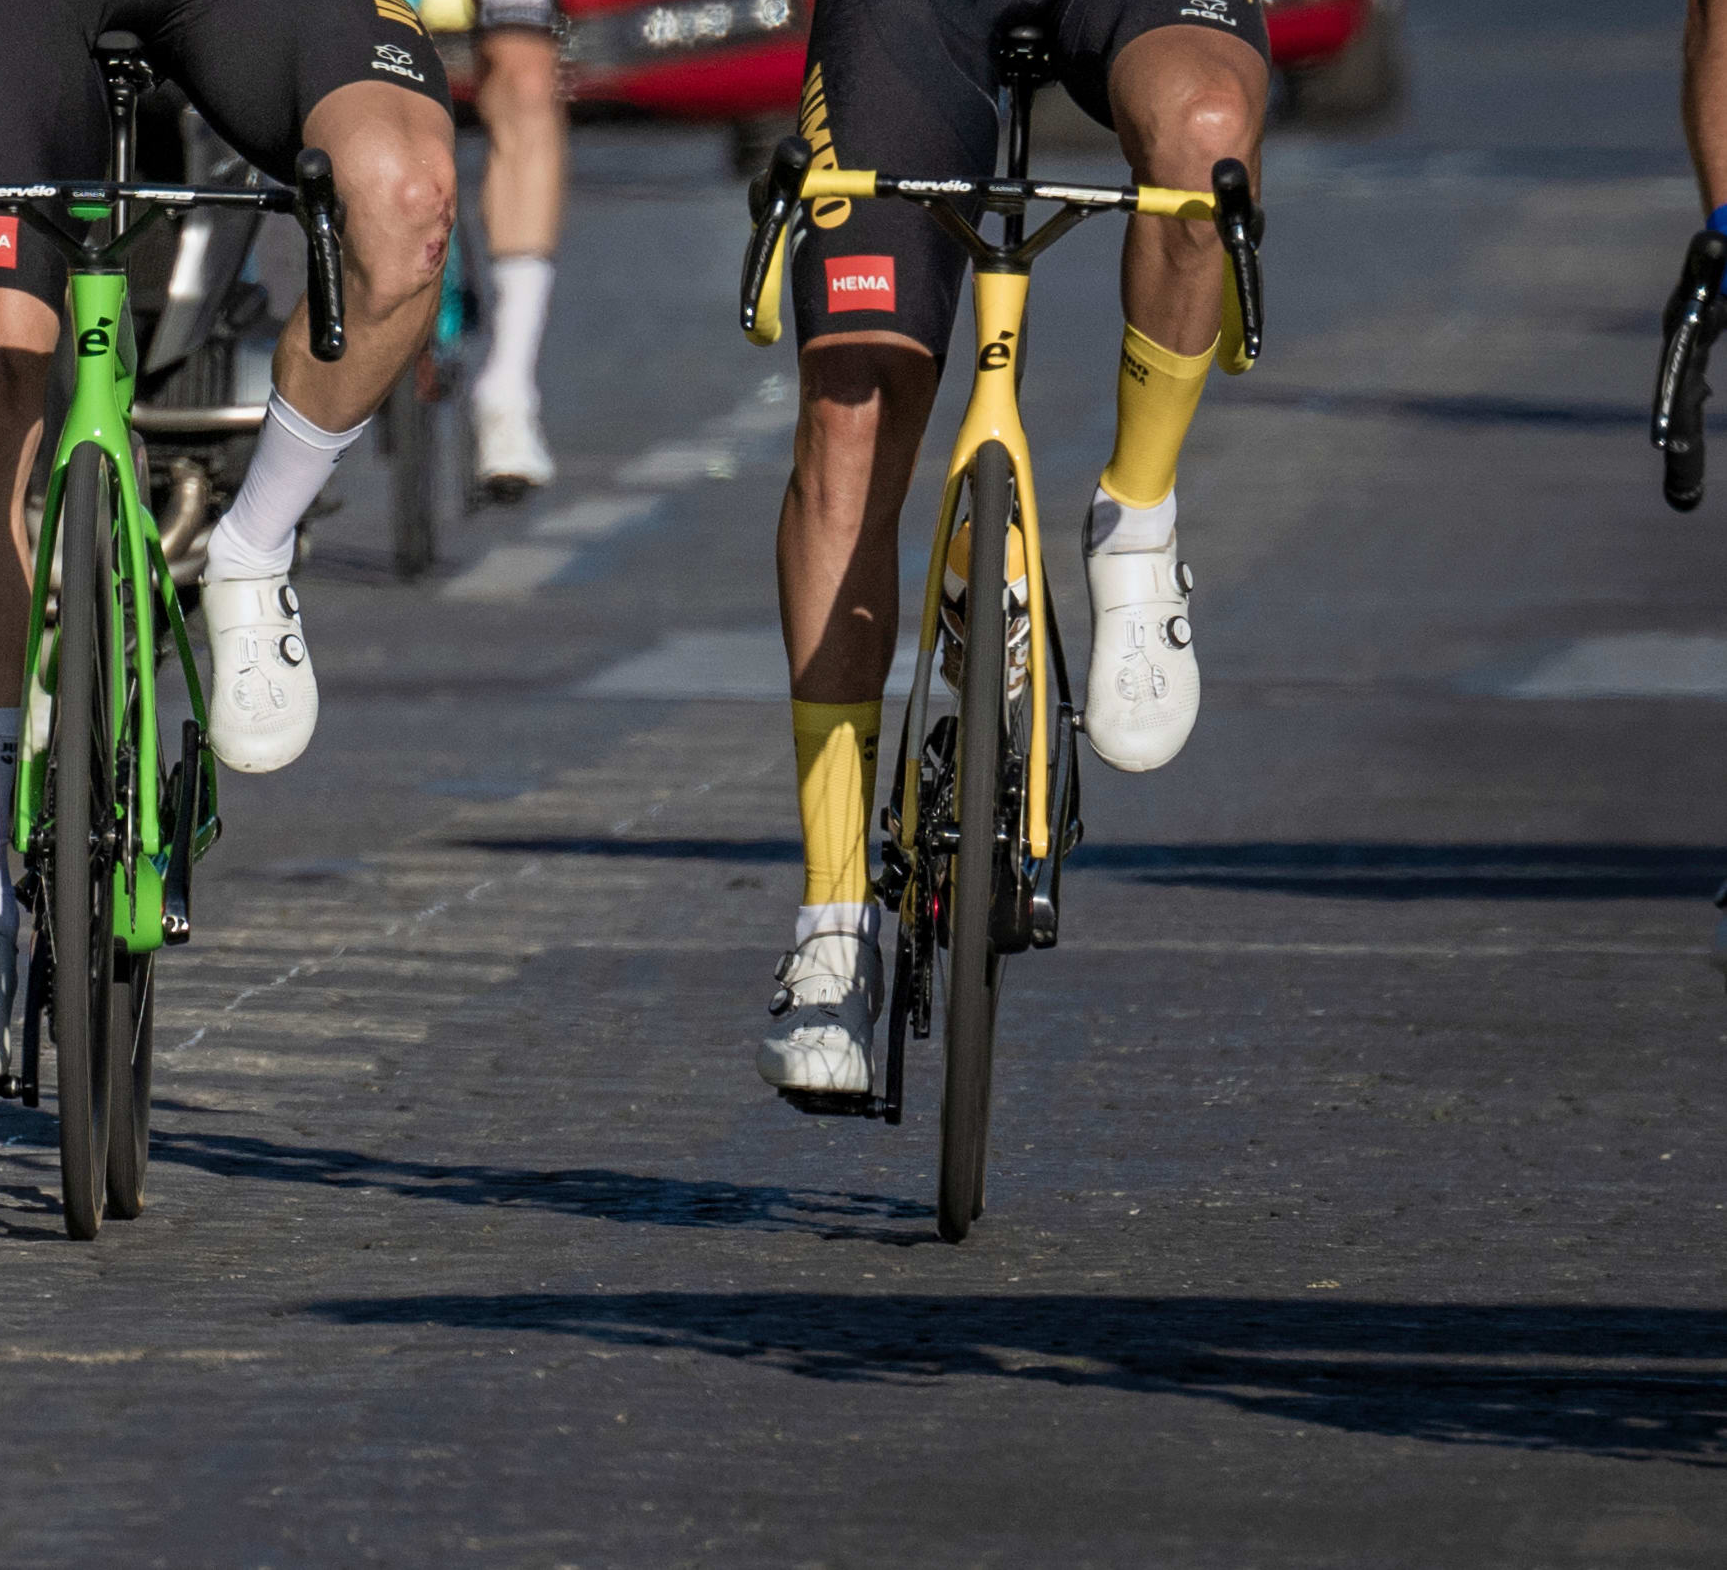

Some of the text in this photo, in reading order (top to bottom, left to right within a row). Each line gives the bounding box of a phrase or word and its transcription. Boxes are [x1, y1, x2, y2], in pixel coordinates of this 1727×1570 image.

[1180, 7, 1237, 27] AGU
[371, 61, 425, 83] AGU
[897, 177, 972, 194] cervélo
[832, 273, 890, 293] HEMA
[77, 315, 112, 358] é
[979, 330, 1015, 373] é
